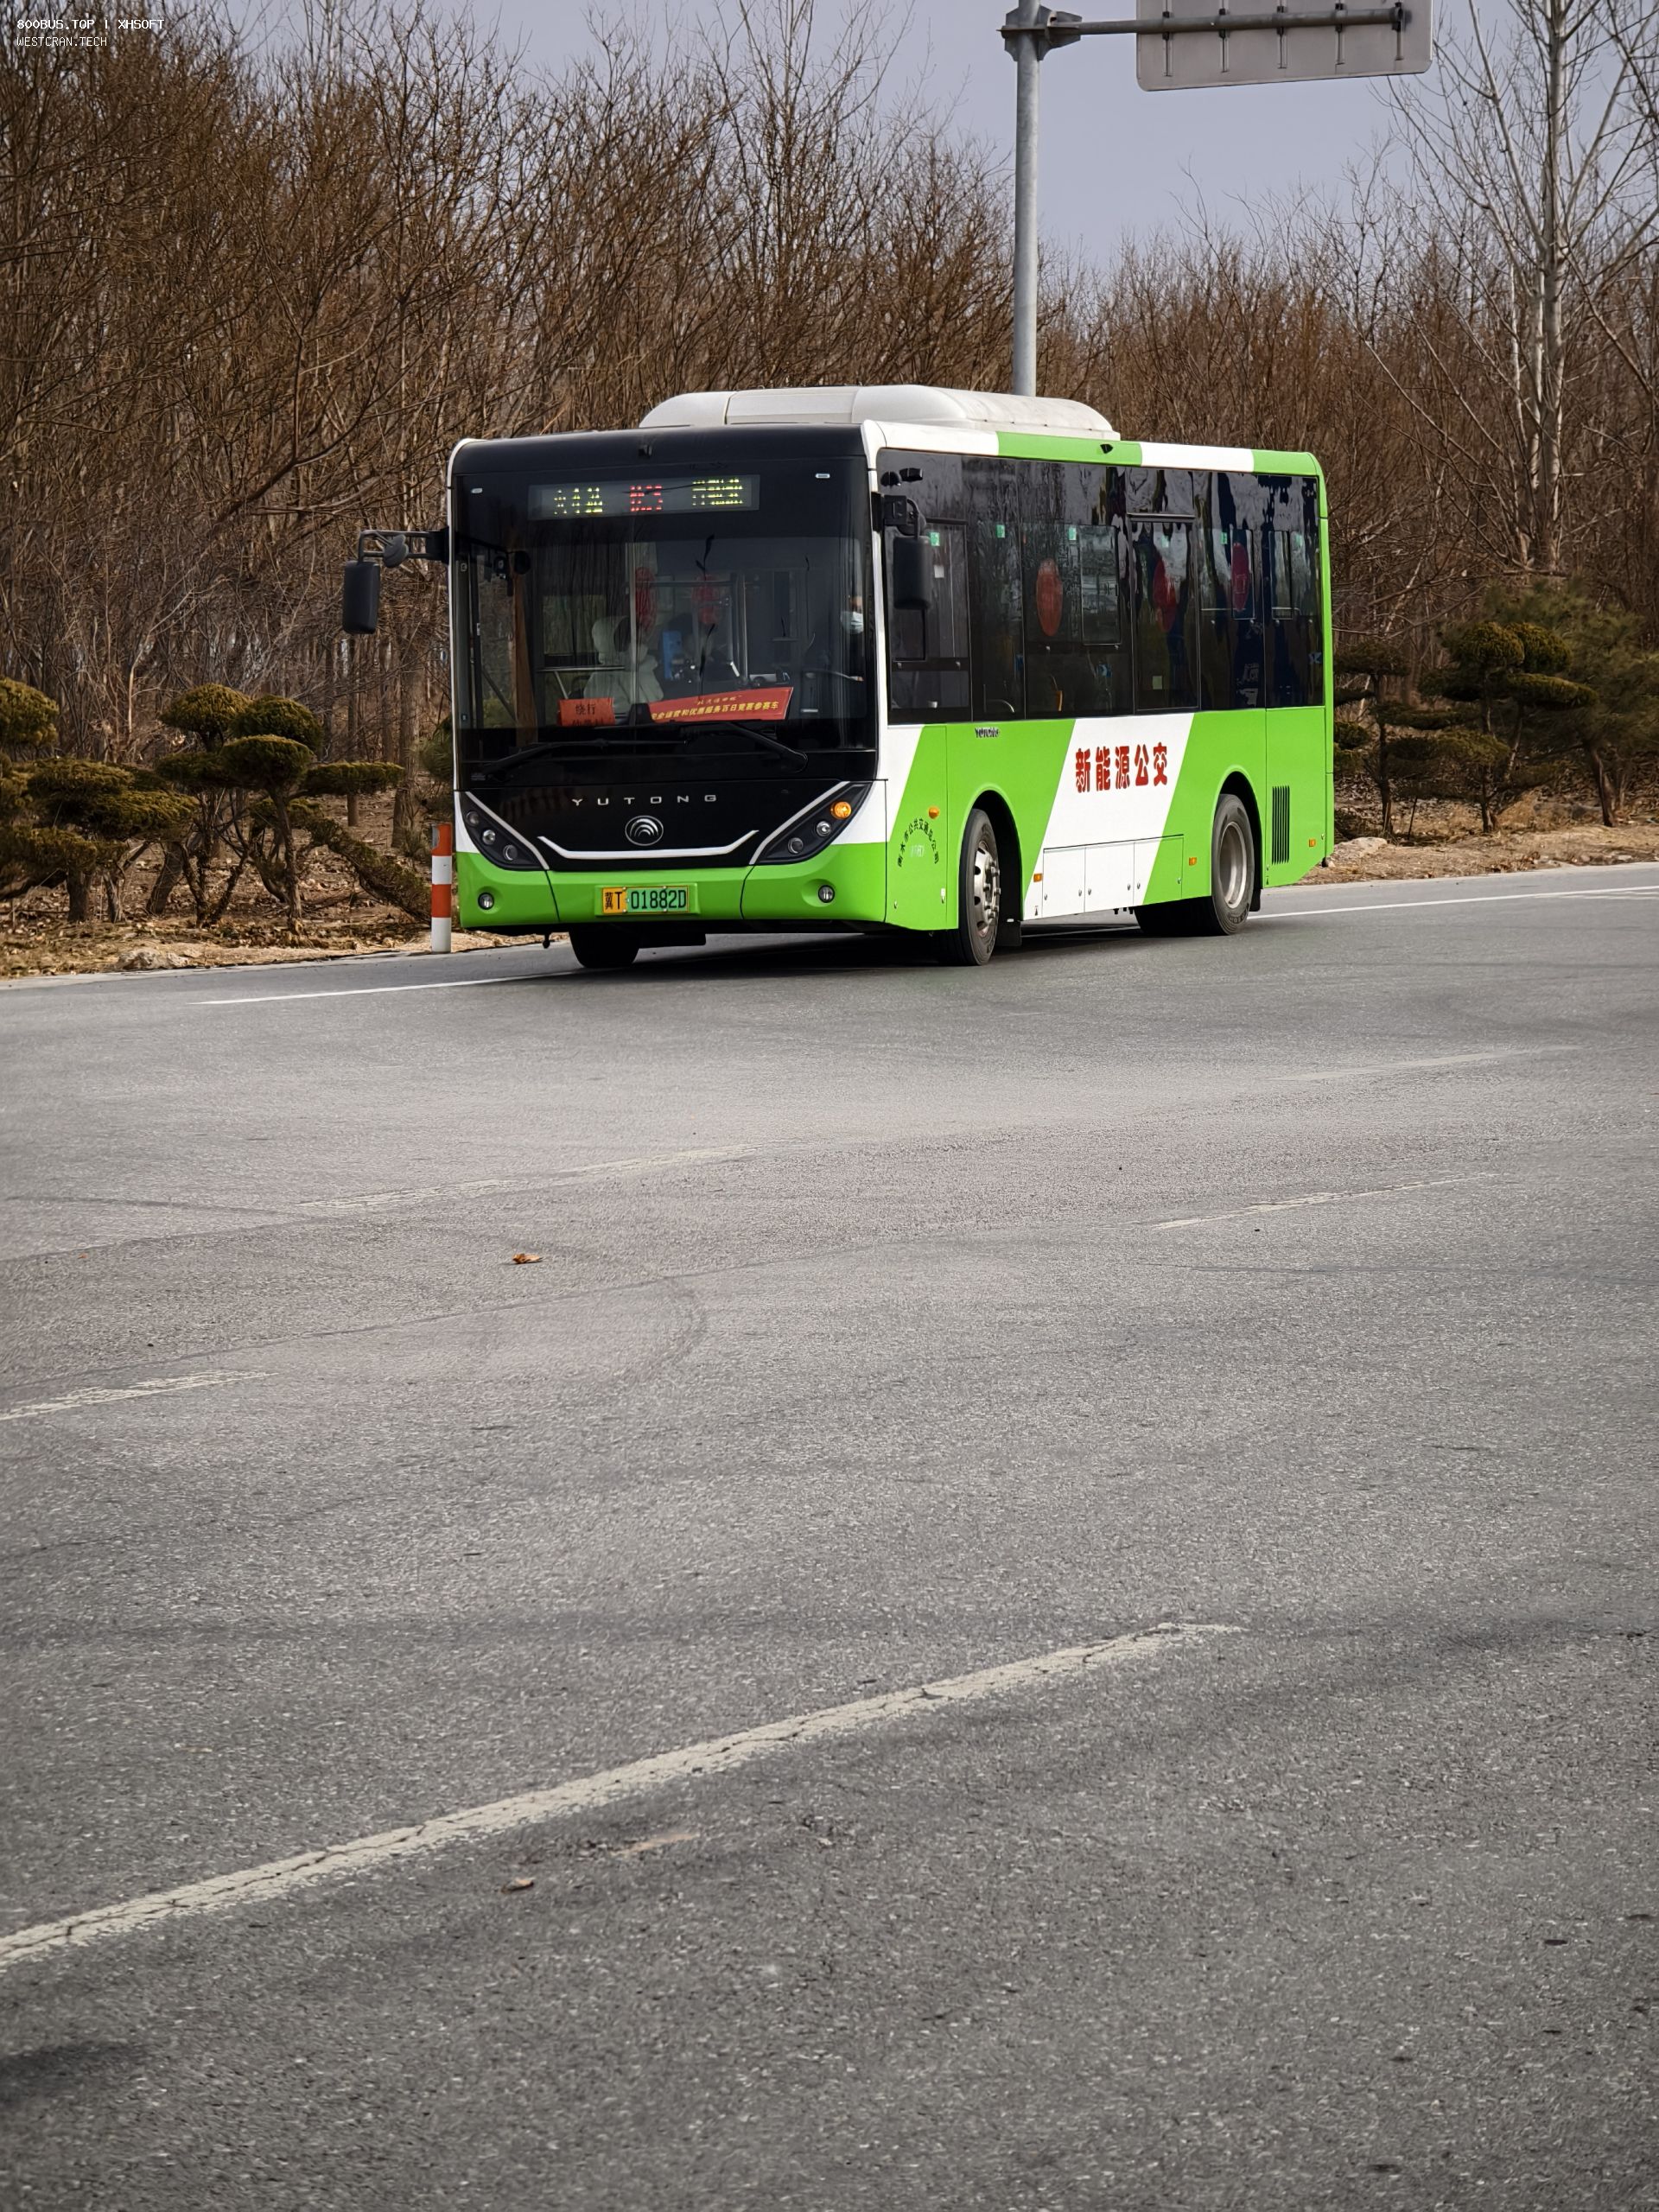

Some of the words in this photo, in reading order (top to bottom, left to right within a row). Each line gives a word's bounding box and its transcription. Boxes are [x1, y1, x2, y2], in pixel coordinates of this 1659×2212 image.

[1075, 741, 1167, 793] 新能源公交
[572, 794, 717, 806] YUTONG
